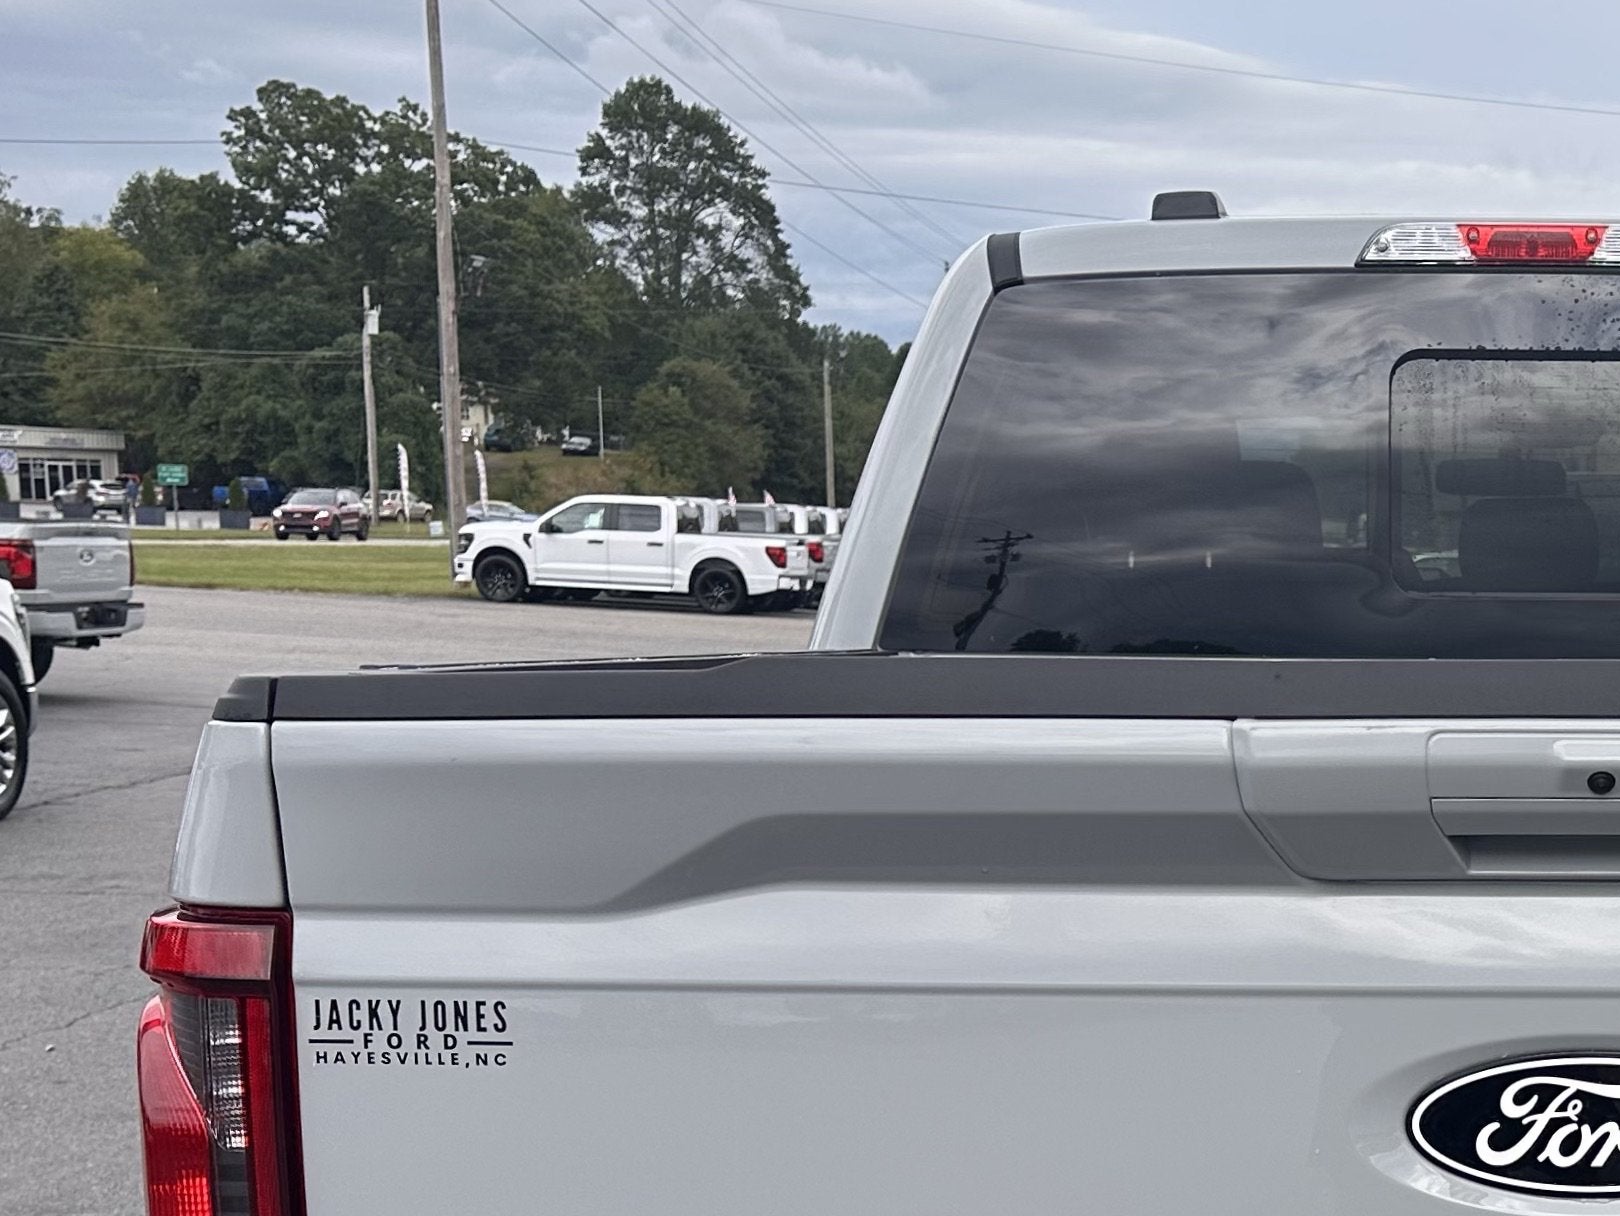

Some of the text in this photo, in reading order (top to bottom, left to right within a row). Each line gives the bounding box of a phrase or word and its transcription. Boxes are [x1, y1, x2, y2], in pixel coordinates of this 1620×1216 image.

[312, 999, 508, 1033] JACKY JONES
[362, 1032, 458, 1051] FORD
